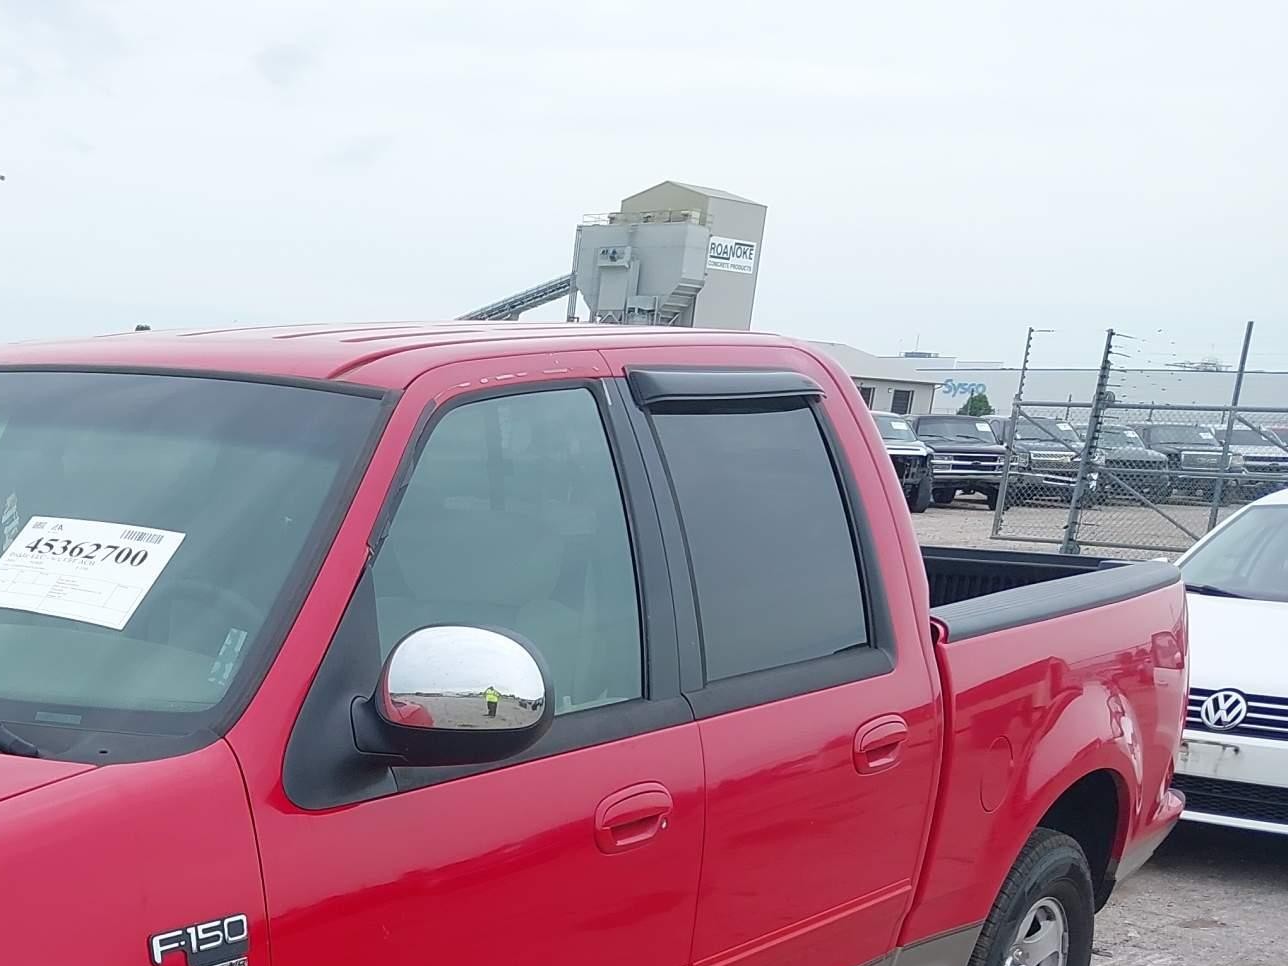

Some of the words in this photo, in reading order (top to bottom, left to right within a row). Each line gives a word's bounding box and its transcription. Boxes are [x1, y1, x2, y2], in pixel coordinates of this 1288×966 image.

[709, 242, 755, 261] ROANOKE
[942, 378, 987, 398] Sysco
[24, 536, 149, 567] 45362700
